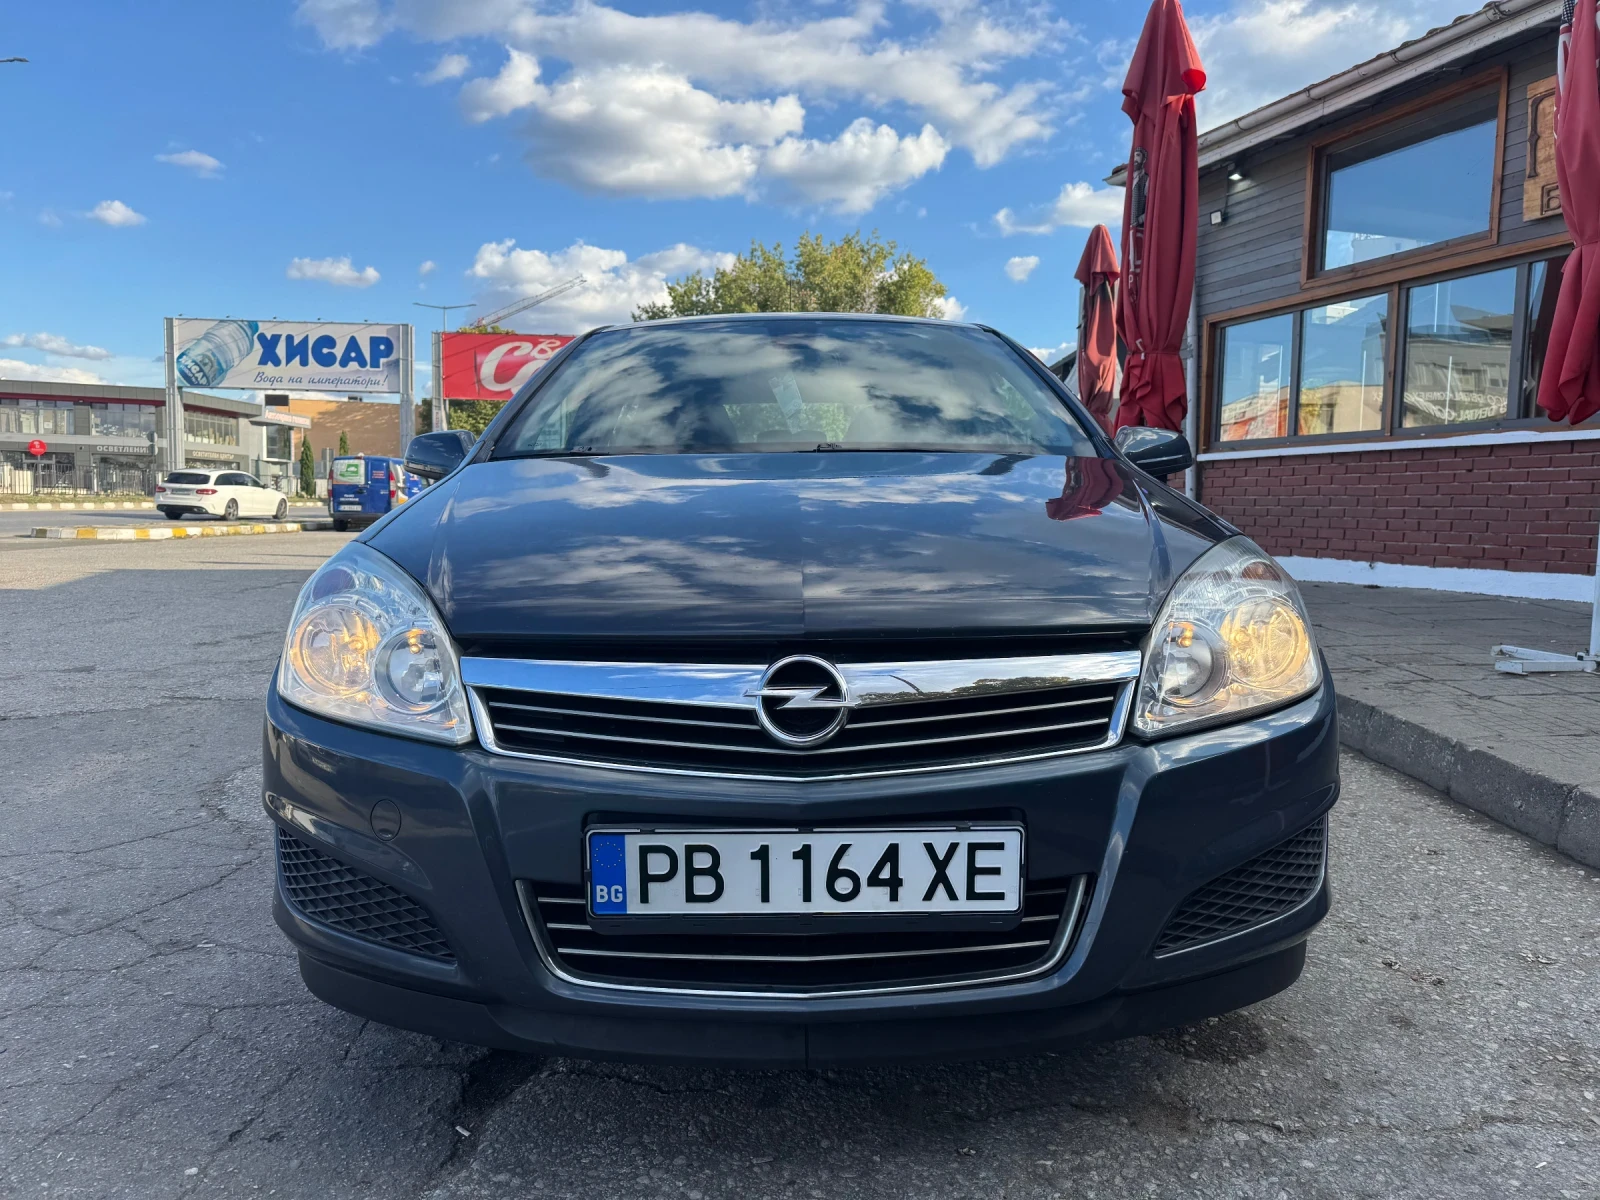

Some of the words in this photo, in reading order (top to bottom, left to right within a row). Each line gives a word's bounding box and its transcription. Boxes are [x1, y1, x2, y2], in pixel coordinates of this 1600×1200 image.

[256, 332, 395, 369] ХИСАР
[253, 371, 284, 387] Вода
[287, 375, 303, 384] на
[307, 374, 389, 388] императори!
[638, 844, 725, 904] PB
[750, 843, 904, 903] 1164
[921, 842, 1006, 901] XE
[596, 885, 624, 903] BG
